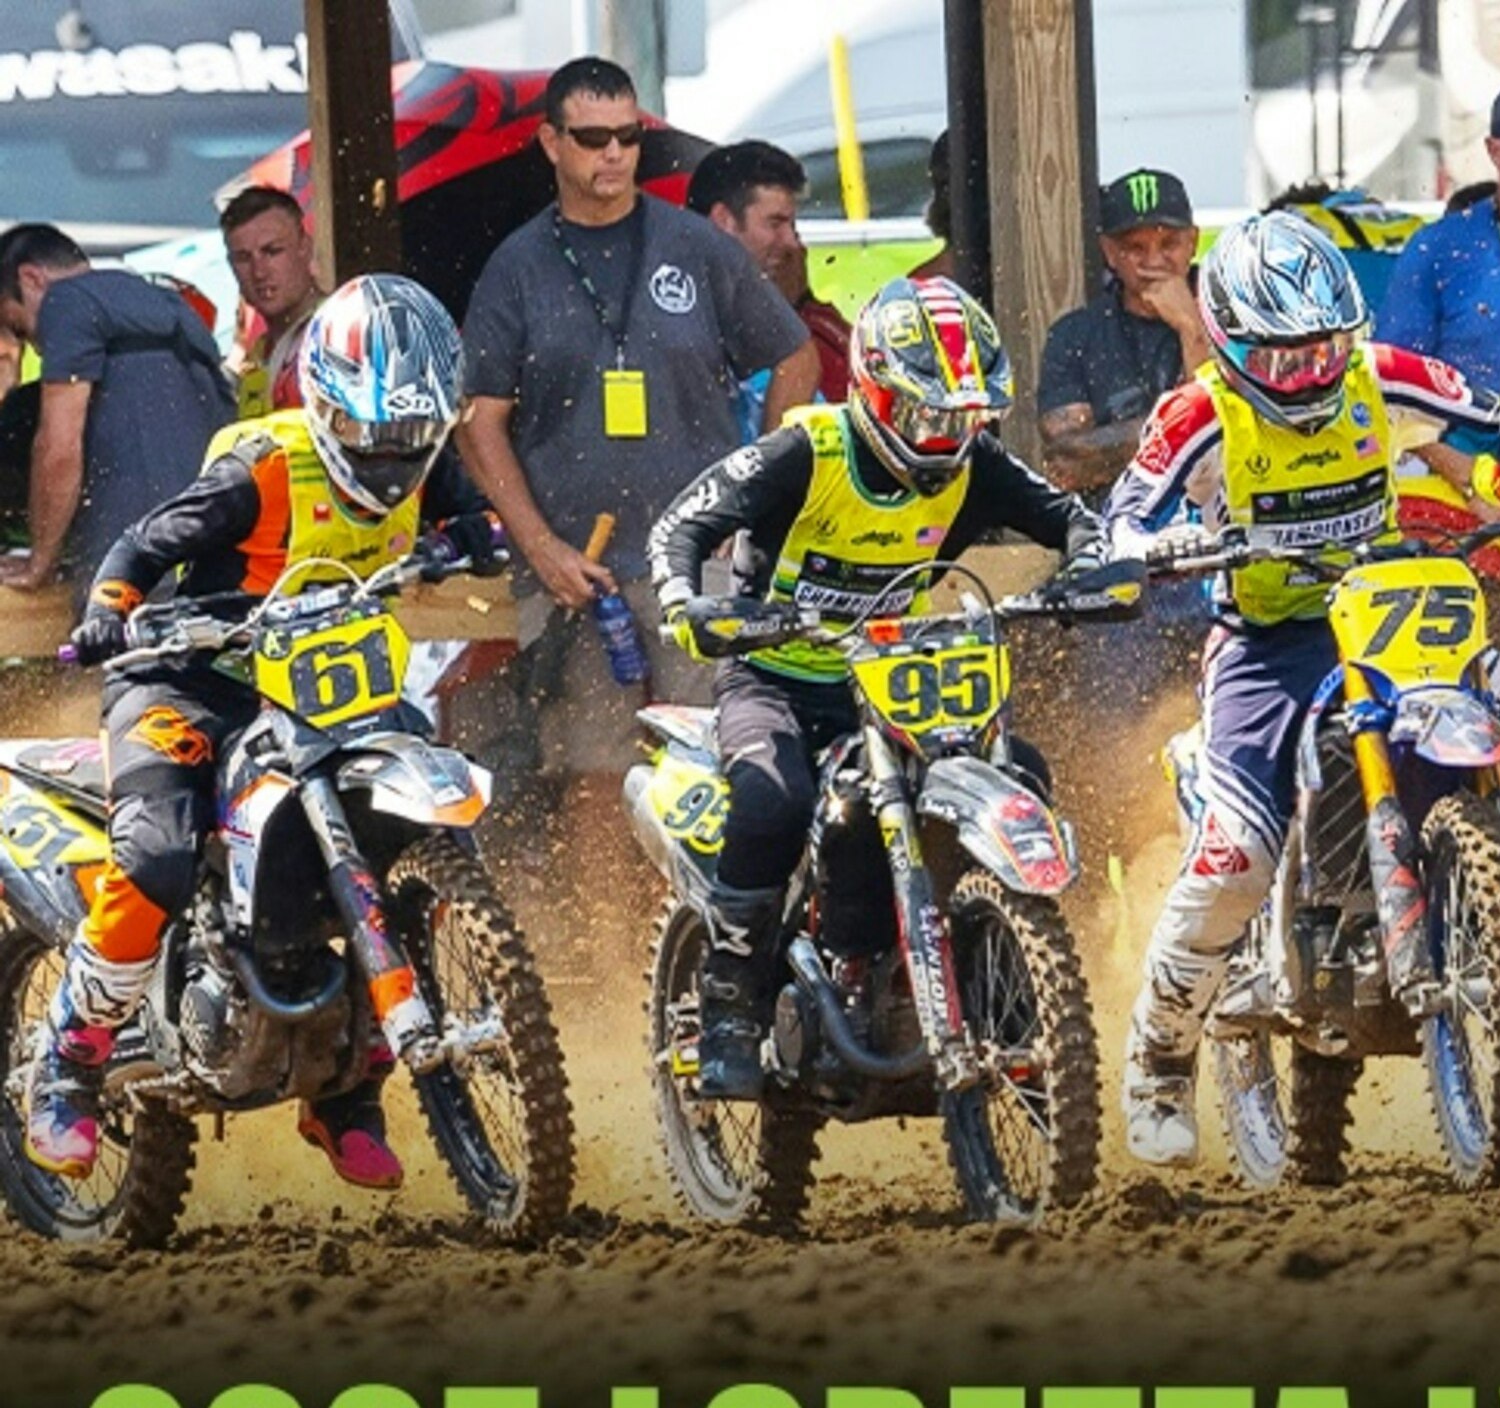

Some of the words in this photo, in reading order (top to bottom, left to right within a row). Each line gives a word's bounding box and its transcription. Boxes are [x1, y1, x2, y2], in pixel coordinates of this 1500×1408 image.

[1361, 584, 1477, 659] 75
[289, 627, 396, 718] 61
[888, 654, 992, 724] 95
